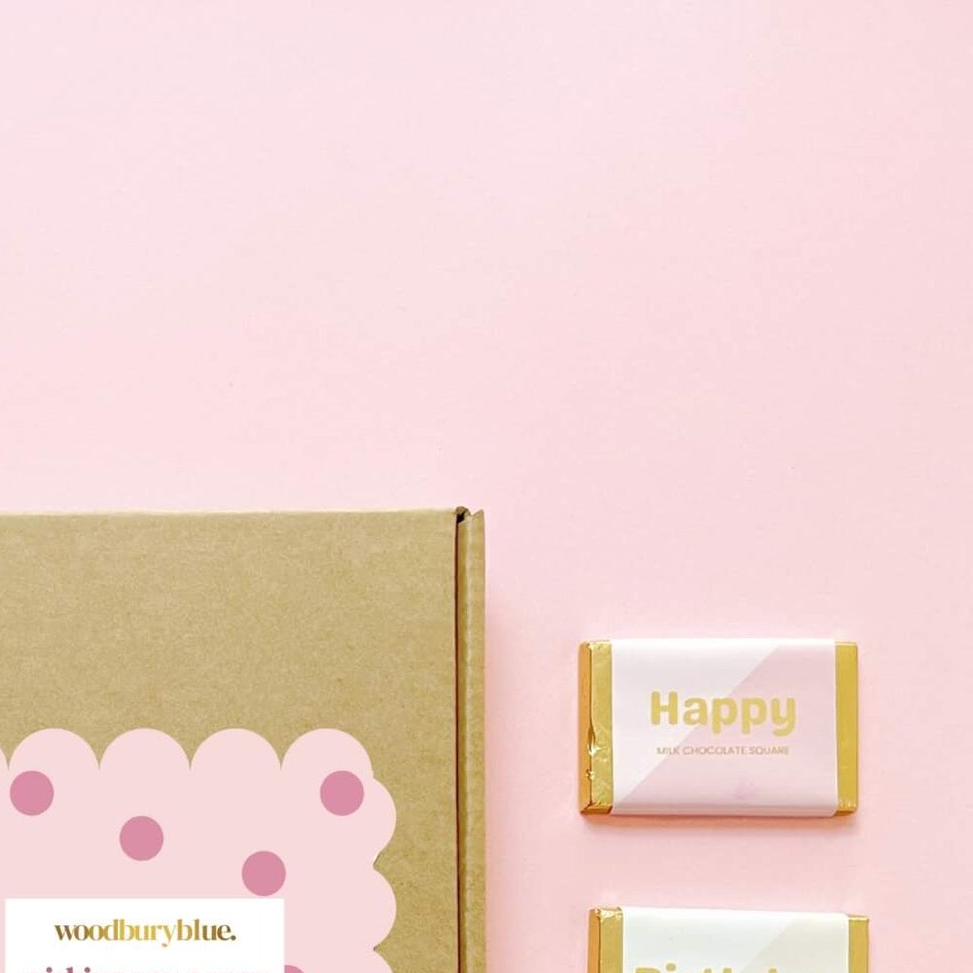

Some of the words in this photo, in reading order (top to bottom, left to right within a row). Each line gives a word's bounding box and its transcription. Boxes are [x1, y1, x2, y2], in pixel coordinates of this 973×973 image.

[650, 691, 796, 737] Happy
[656, 746, 679, 756] MILK
[682, 746, 746, 756] CHOCOLATE
[748, 746, 790, 756] SQUARE
[54, 918, 237, 948] woodburyblue.
